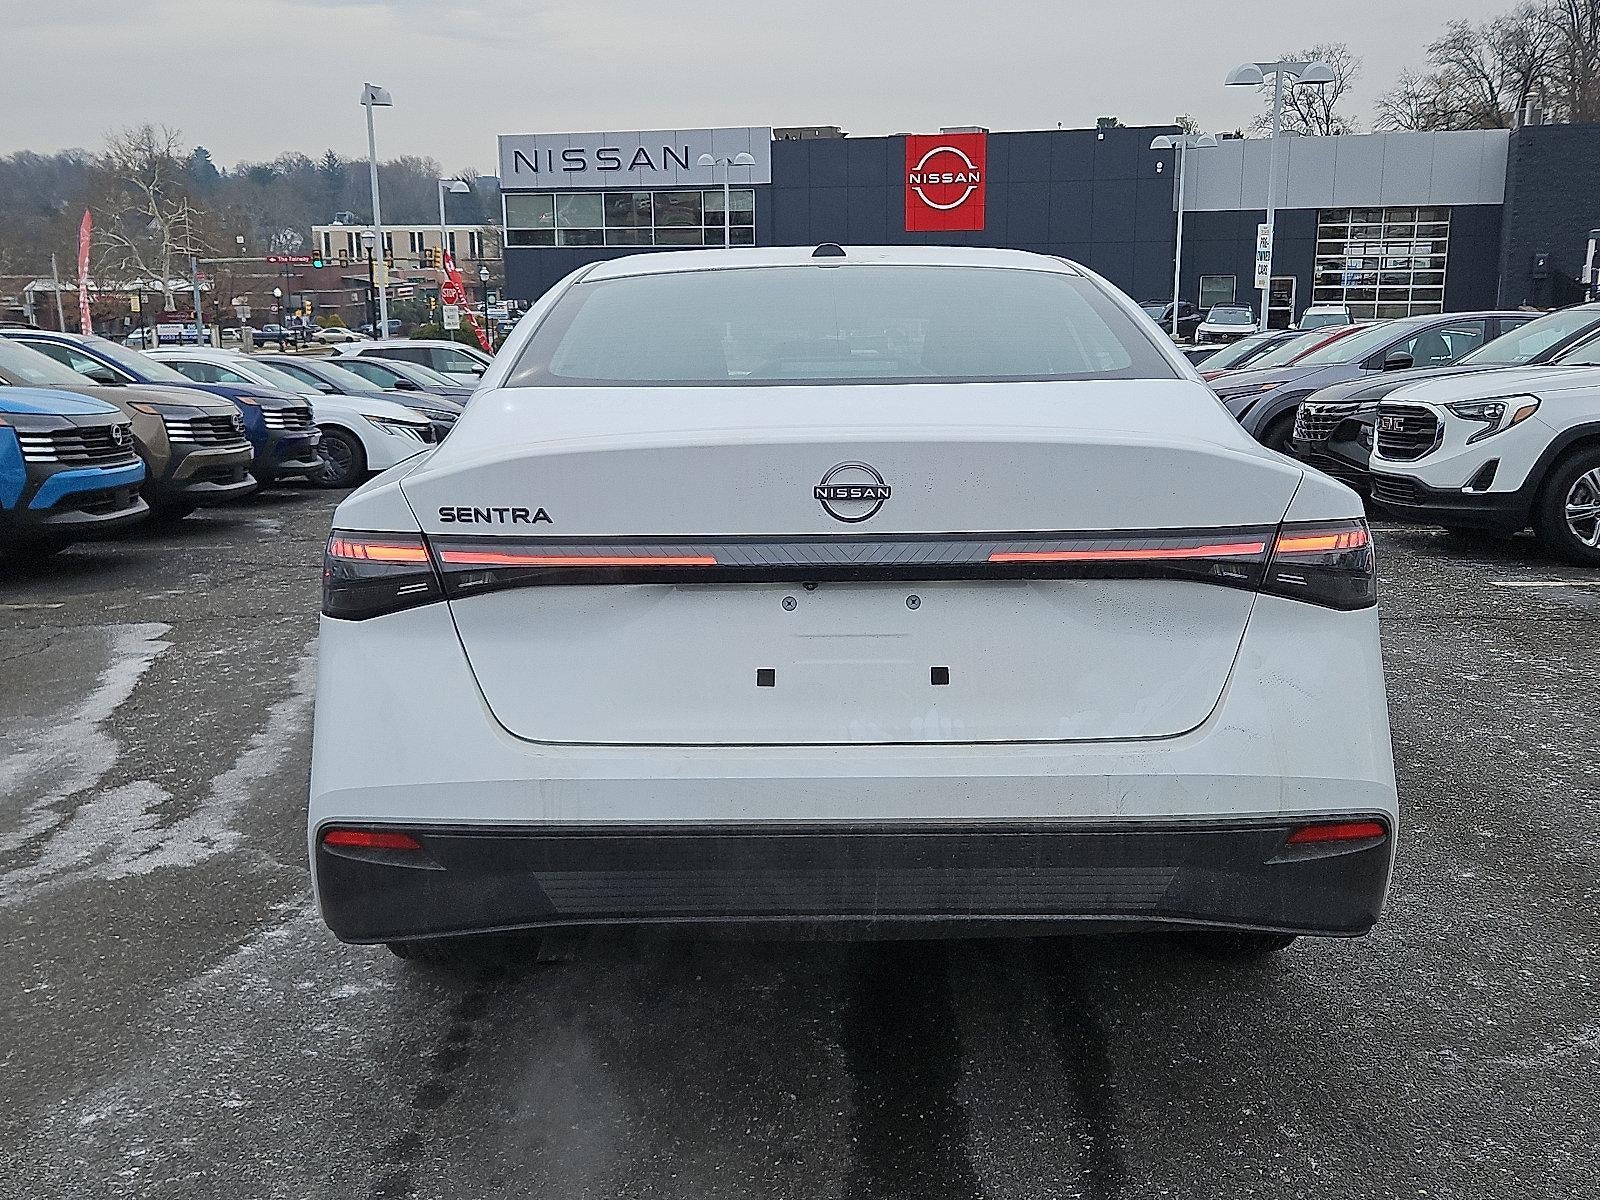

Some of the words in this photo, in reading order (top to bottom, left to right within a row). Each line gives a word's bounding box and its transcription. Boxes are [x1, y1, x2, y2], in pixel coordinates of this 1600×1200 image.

[513, 146, 690, 172] NISSAN
[909, 171, 980, 184] NISSAN
[442, 288, 456, 297] STOP
[816, 488, 889, 498] NISSAN
[438, 507, 554, 524] SENTRA
